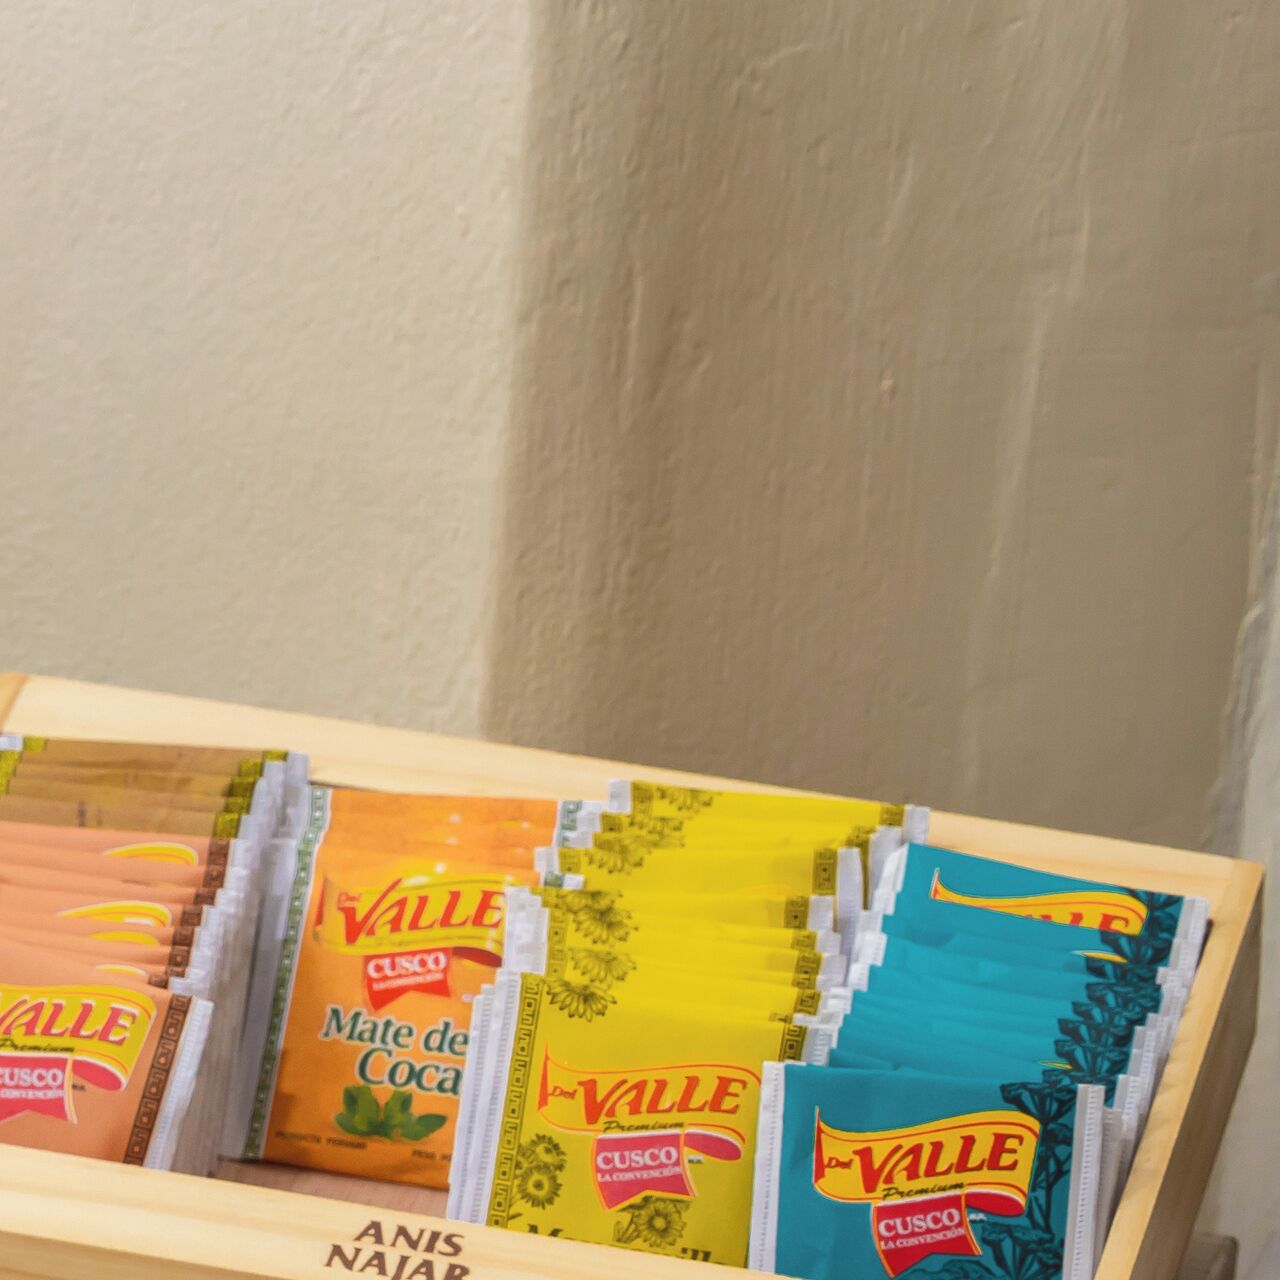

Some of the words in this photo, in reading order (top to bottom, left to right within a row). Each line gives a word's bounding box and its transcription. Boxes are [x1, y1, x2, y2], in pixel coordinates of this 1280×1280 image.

[336, 877, 505, 946] VALLE
[366, 950, 448, 980] CUSCO
[322, 1006, 414, 1049] Mate
[423, 1020, 469, 1057] de
[357, 1047, 463, 1096] Coca
[577, 1074, 748, 1126] VALLE
[602, 1119, 686, 1133] Premium
[596, 1146, 679, 1170] CUSCO
[852, 1131, 1025, 1194] VALLE
[596, 1172, 612, 1183] LA
[881, 1181, 966, 1201] Premium
[877, 1207, 962, 1238] CUSCO
[880, 1239, 895, 1250] LA
[895, 1226, 966, 1249] CONVENCIÓN
[353, 1219, 466, 1258] ANIS
